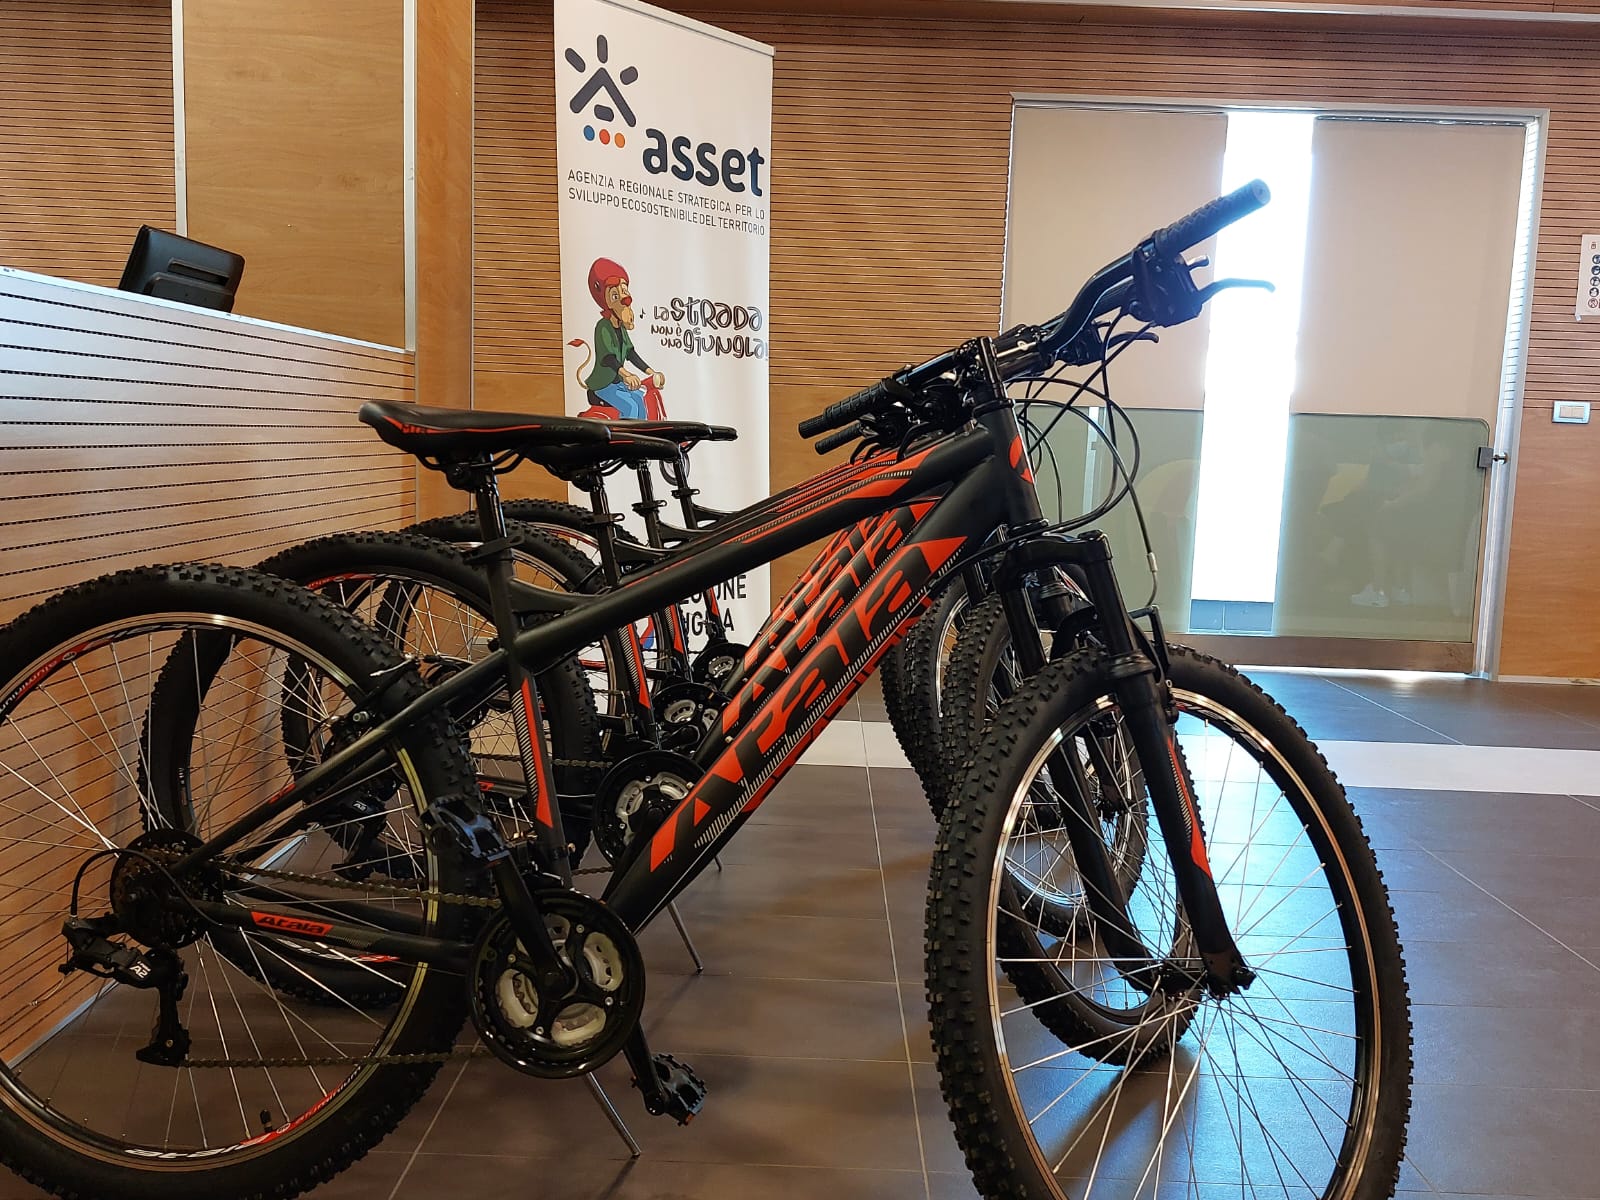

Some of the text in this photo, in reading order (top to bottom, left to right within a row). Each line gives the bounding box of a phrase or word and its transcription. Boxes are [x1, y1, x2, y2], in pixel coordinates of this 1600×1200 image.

[642, 128, 765, 197] asset
[568, 168, 765, 220] AGENZIA REGIONALE STRATEGICA PER LO
[568, 187, 765, 236] SVILUPPO ECOSOSTENIBILE DEL TERRITORIO
